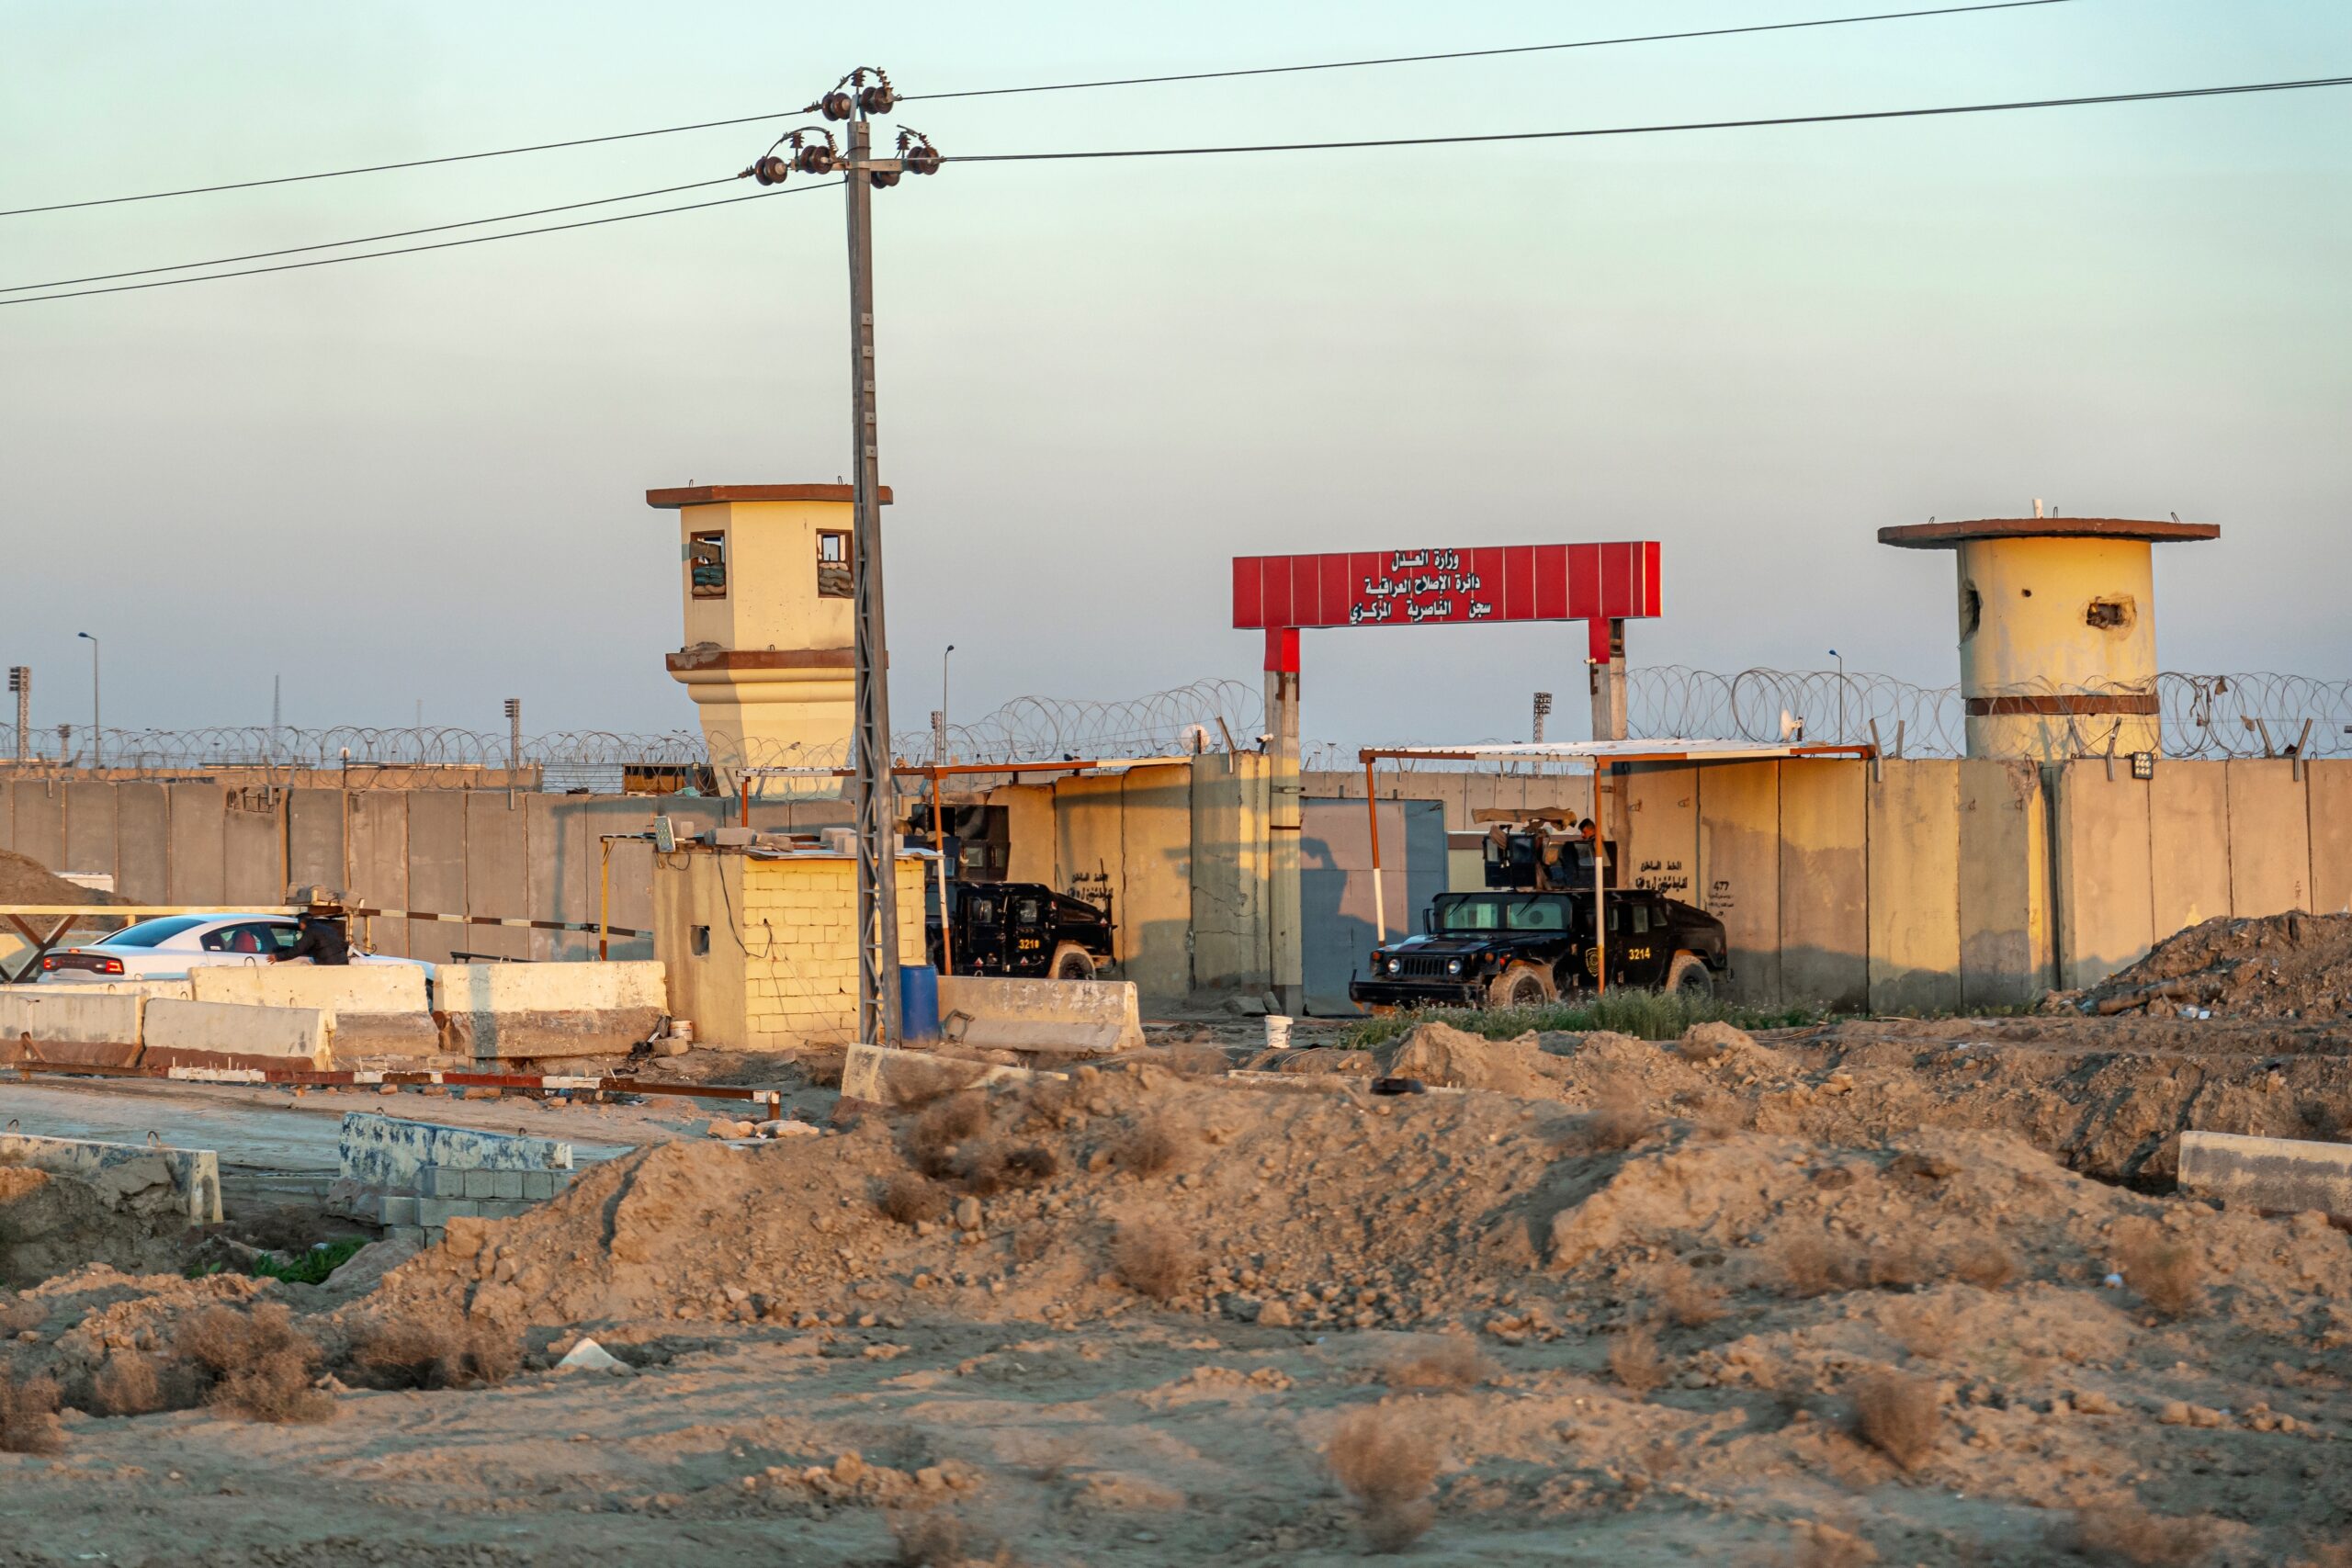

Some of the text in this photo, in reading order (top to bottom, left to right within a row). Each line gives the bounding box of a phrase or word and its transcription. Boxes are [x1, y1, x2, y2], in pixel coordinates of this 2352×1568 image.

[1391, 548, 1459, 571] وزارة العدل
[1364, 573, 1480, 599] دائرة الإصلاح العراقية
[1350, 599, 1491, 626] سجن الناصرية المركزي
[1628, 947, 1651, 960] 3214
